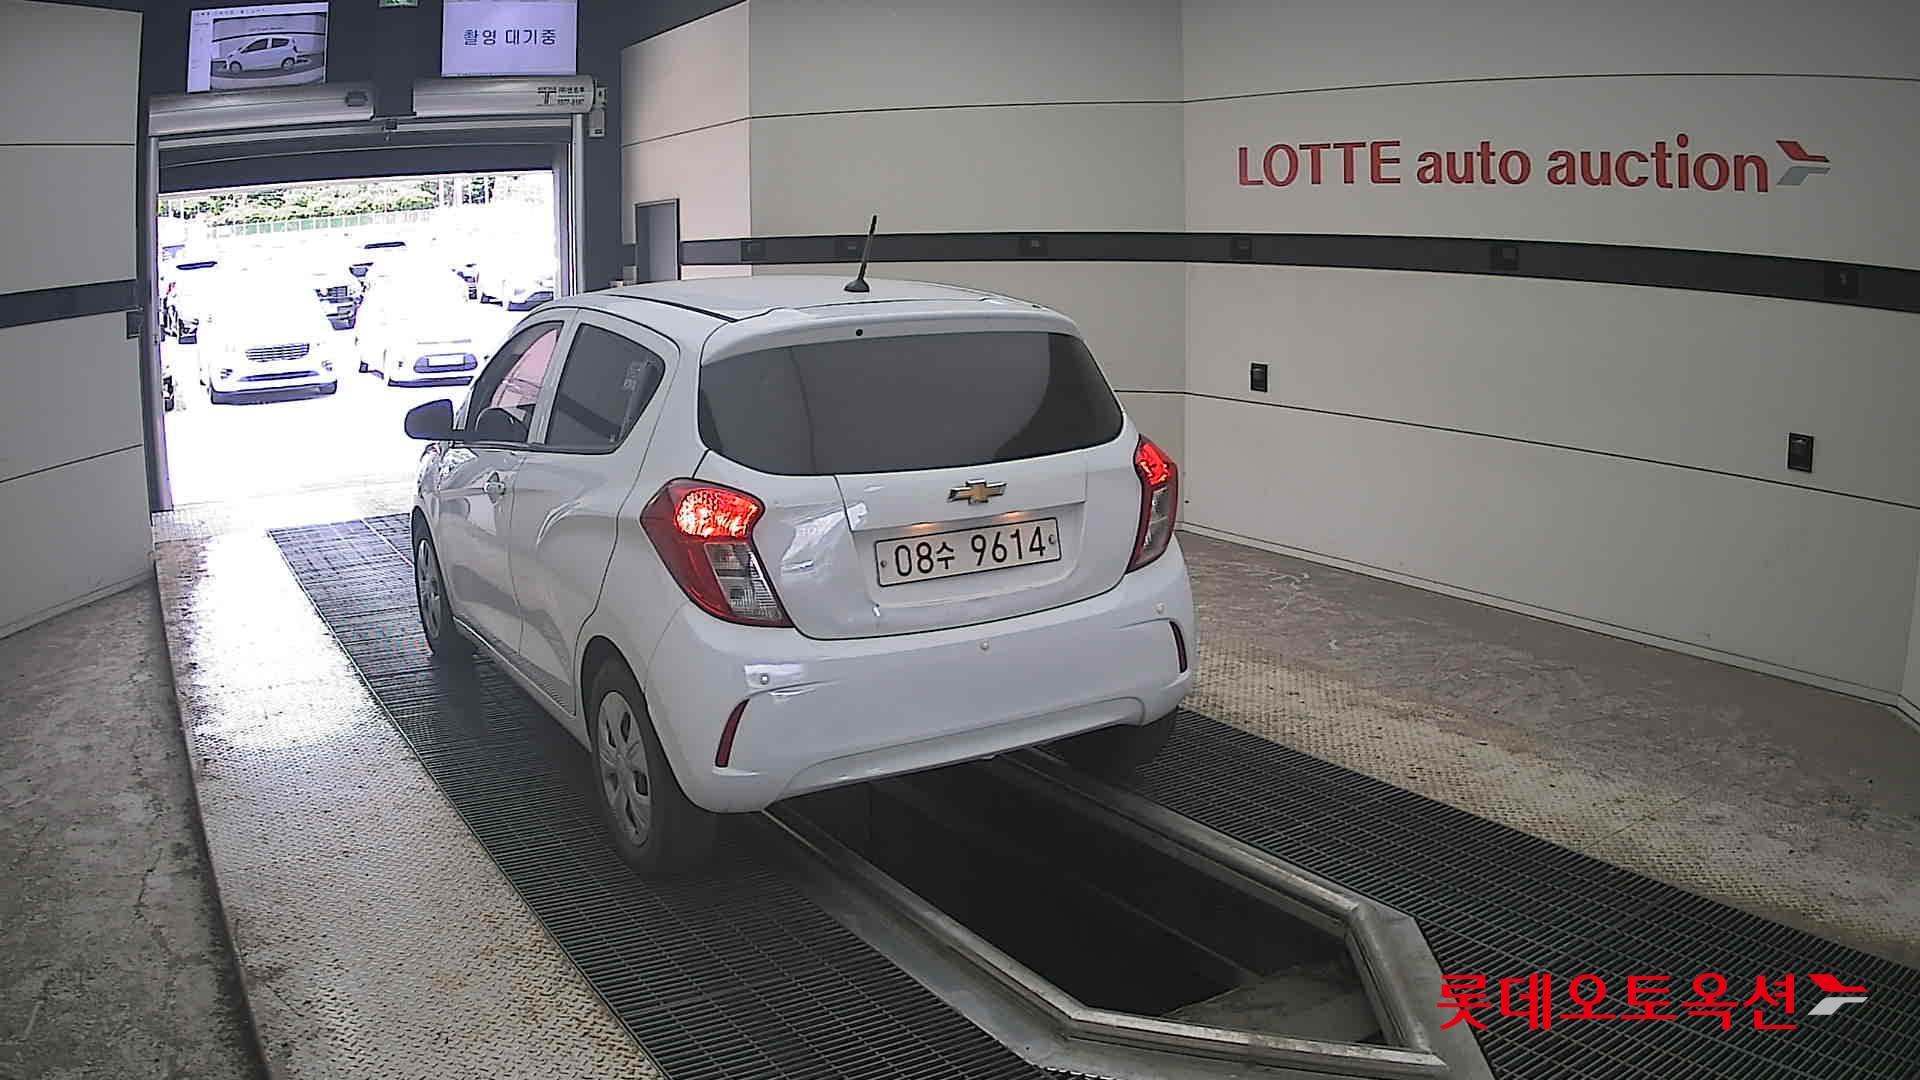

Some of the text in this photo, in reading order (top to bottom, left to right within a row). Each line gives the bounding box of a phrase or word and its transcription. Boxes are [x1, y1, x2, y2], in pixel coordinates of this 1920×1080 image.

[463, 29, 556, 46] 촬영 대기중
[1238, 133, 1769, 193] LOTTE auto auction
[894, 526, 1046, 577] 08수 9614
